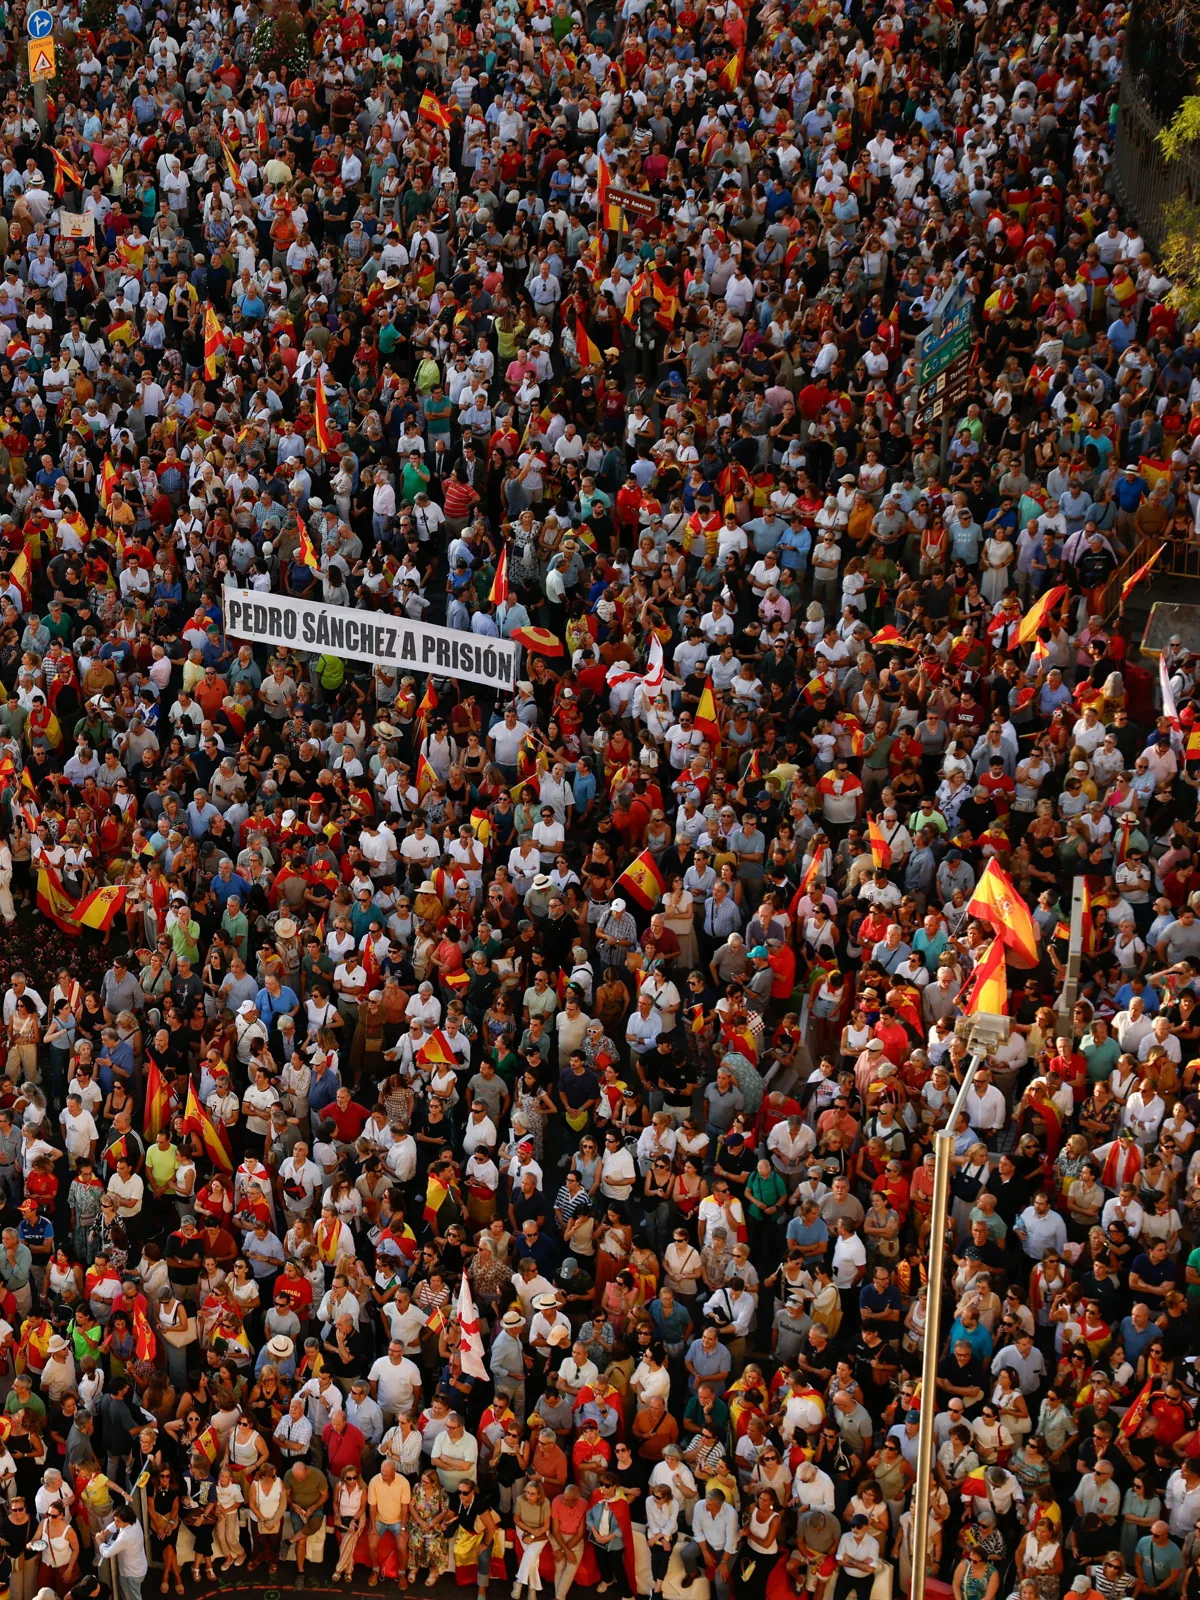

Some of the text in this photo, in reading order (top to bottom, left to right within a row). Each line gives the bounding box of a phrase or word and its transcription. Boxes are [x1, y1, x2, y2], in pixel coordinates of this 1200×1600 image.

[608, 193, 621, 201] Casa
[631, 201, 652, 211] América
[229, 600, 512, 683] PEDRO SÁNCHEZ A PRISIÓN
